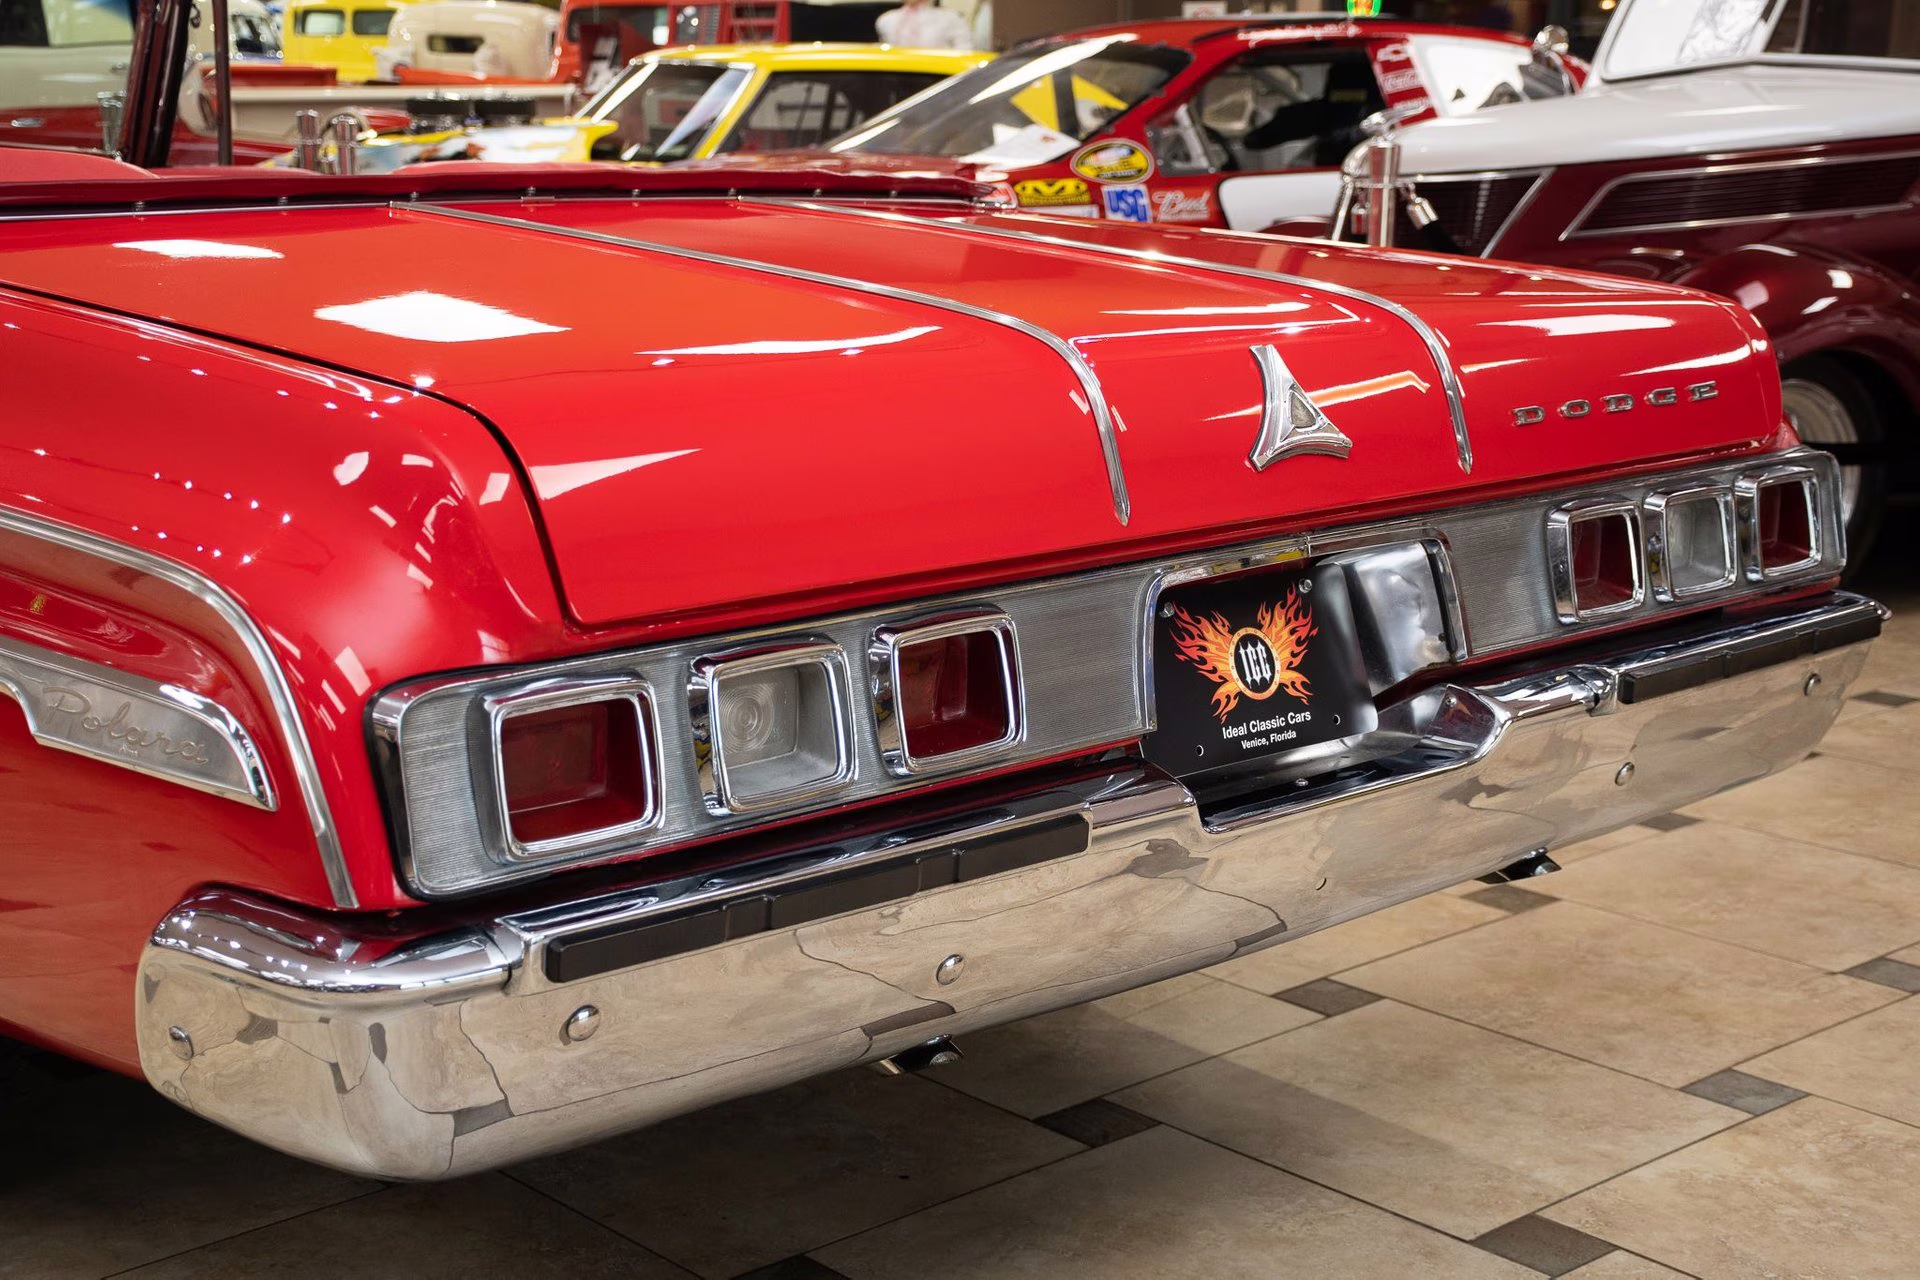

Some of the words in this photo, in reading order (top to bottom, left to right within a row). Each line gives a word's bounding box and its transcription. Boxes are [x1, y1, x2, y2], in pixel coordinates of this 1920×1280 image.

[1511, 380, 1719, 427] DODGE
[41, 685, 208, 766] Polara
[1222, 722, 1248, 739] Ideal
[1249, 715, 1286, 733] Classic
[1287, 711, 1312, 725] Cars
[1241, 737, 1269, 750] Venice,
[1270, 730, 1297, 743] Florida
